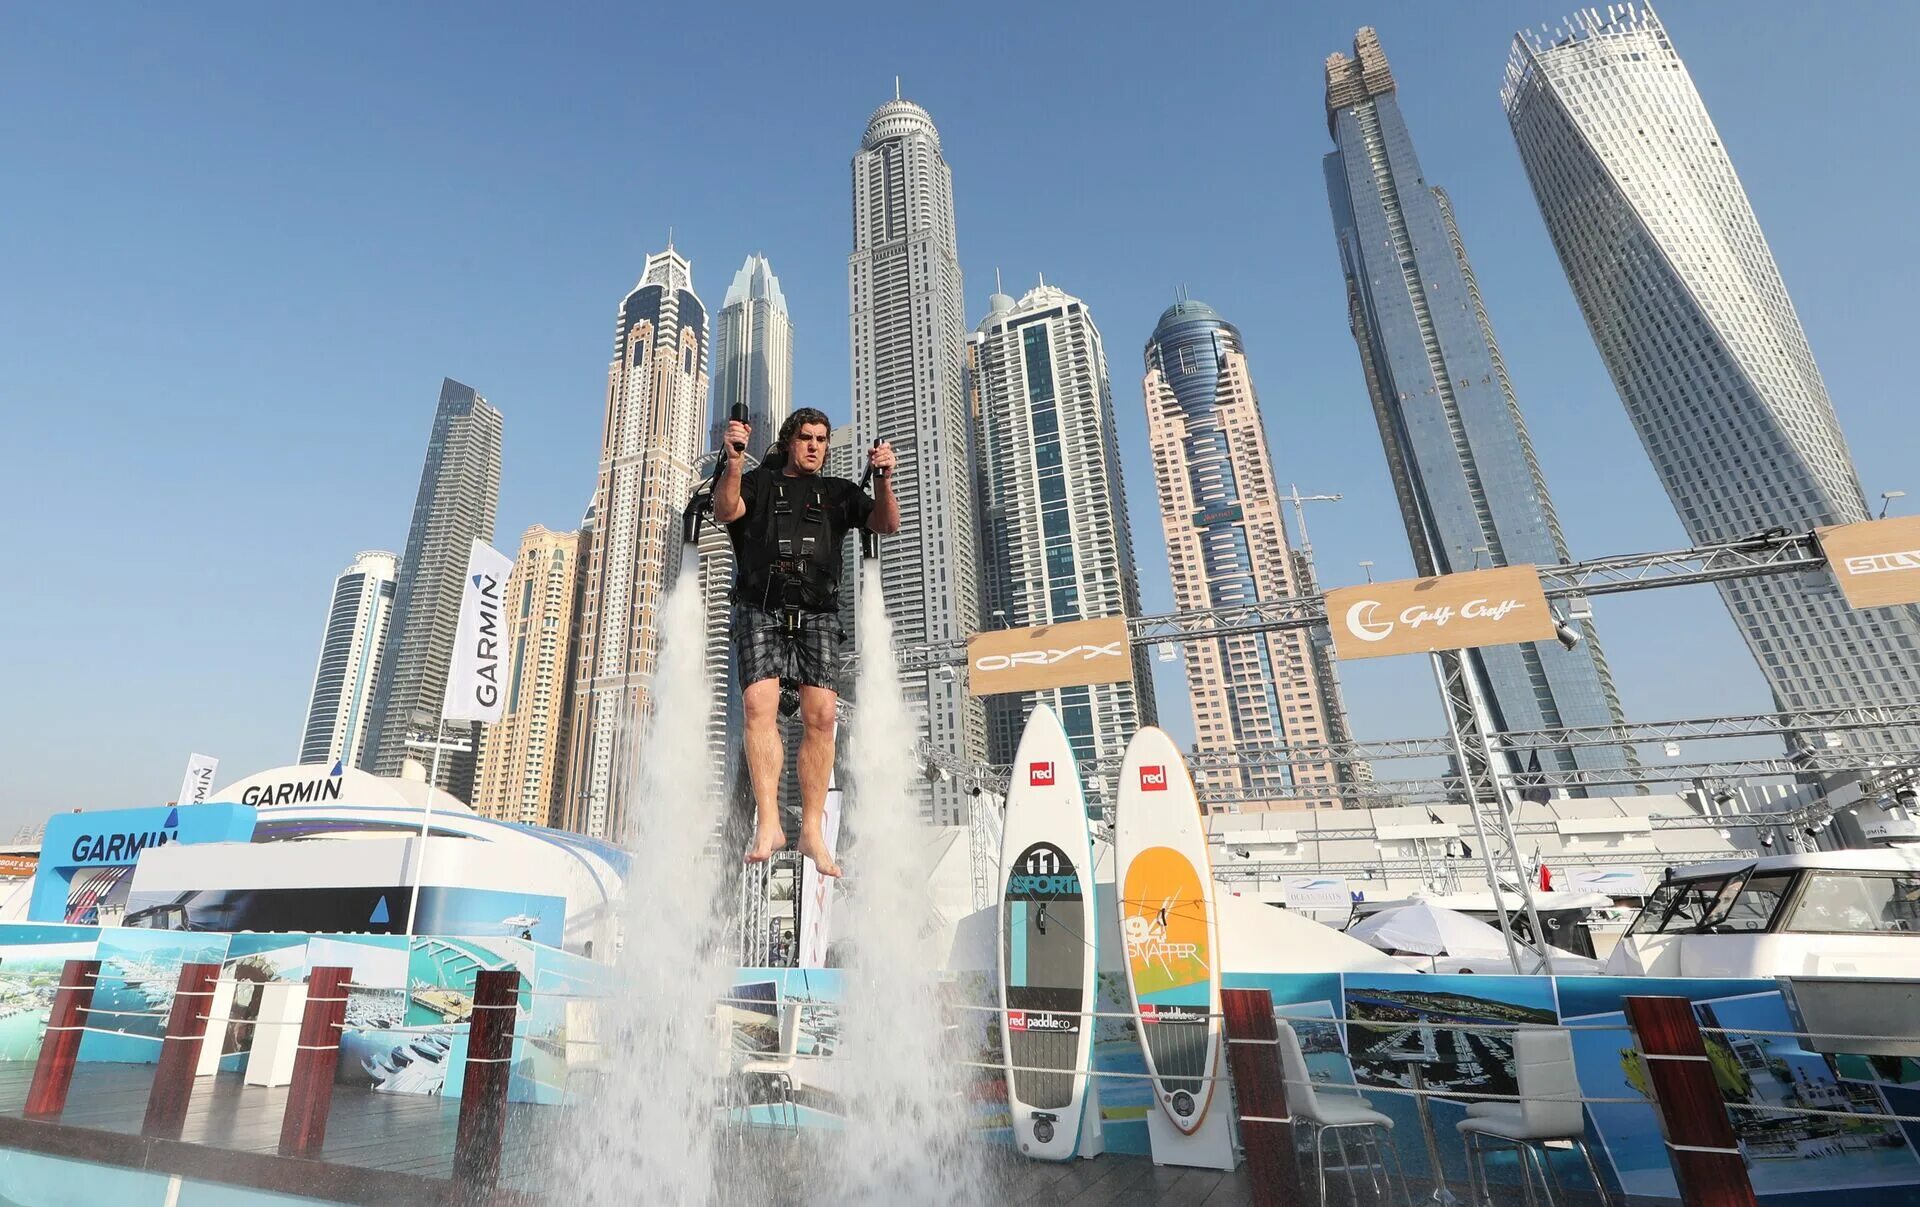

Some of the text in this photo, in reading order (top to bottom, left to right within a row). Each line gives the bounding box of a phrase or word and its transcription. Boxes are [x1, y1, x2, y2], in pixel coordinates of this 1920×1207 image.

[1400, 599, 1526, 628] Gulf Craft
[476, 574, 498, 707] GARMIN
[975, 641, 1122, 671] ORYX
[1031, 762, 1054, 780] red
[1142, 765, 1165, 784] red
[242, 777, 342, 807] GARMIN
[1028, 849, 1060, 874] 11
[1009, 1012, 1025, 1027] red
